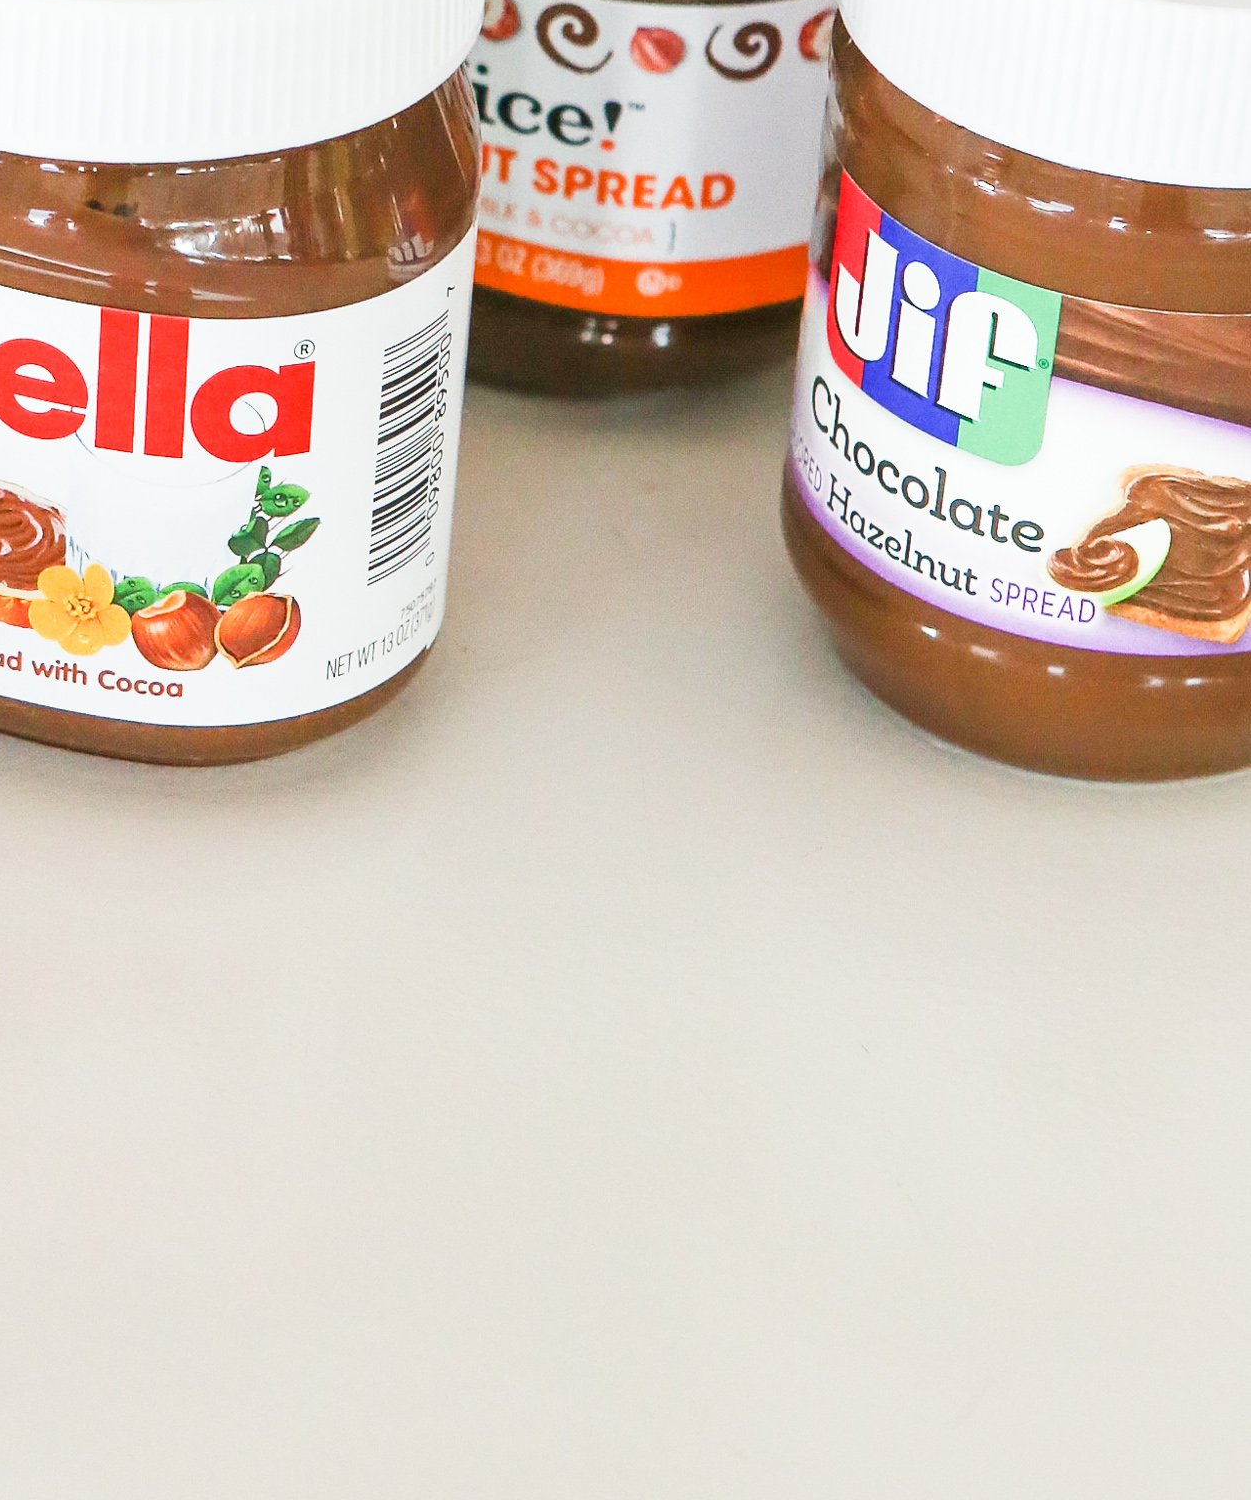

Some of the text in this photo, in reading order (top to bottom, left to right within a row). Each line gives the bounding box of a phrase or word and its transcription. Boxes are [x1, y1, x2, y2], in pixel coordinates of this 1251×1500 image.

[465, 60, 622, 152] ice!
[532, 157, 736, 212] SPREAD
[835, 228, 1039, 425] Jif
[811, 375, 1045, 554] Chocolate
[826, 473, 979, 597] Hazelnut
[989, 578, 1097, 625] SPREAD
[31, 657, 88, 686] with
[97, 669, 185, 699] Cocoa
[326, 650, 355, 681] NET
[357, 639, 379, 669] WT
[381, 631, 395, 657] 13
